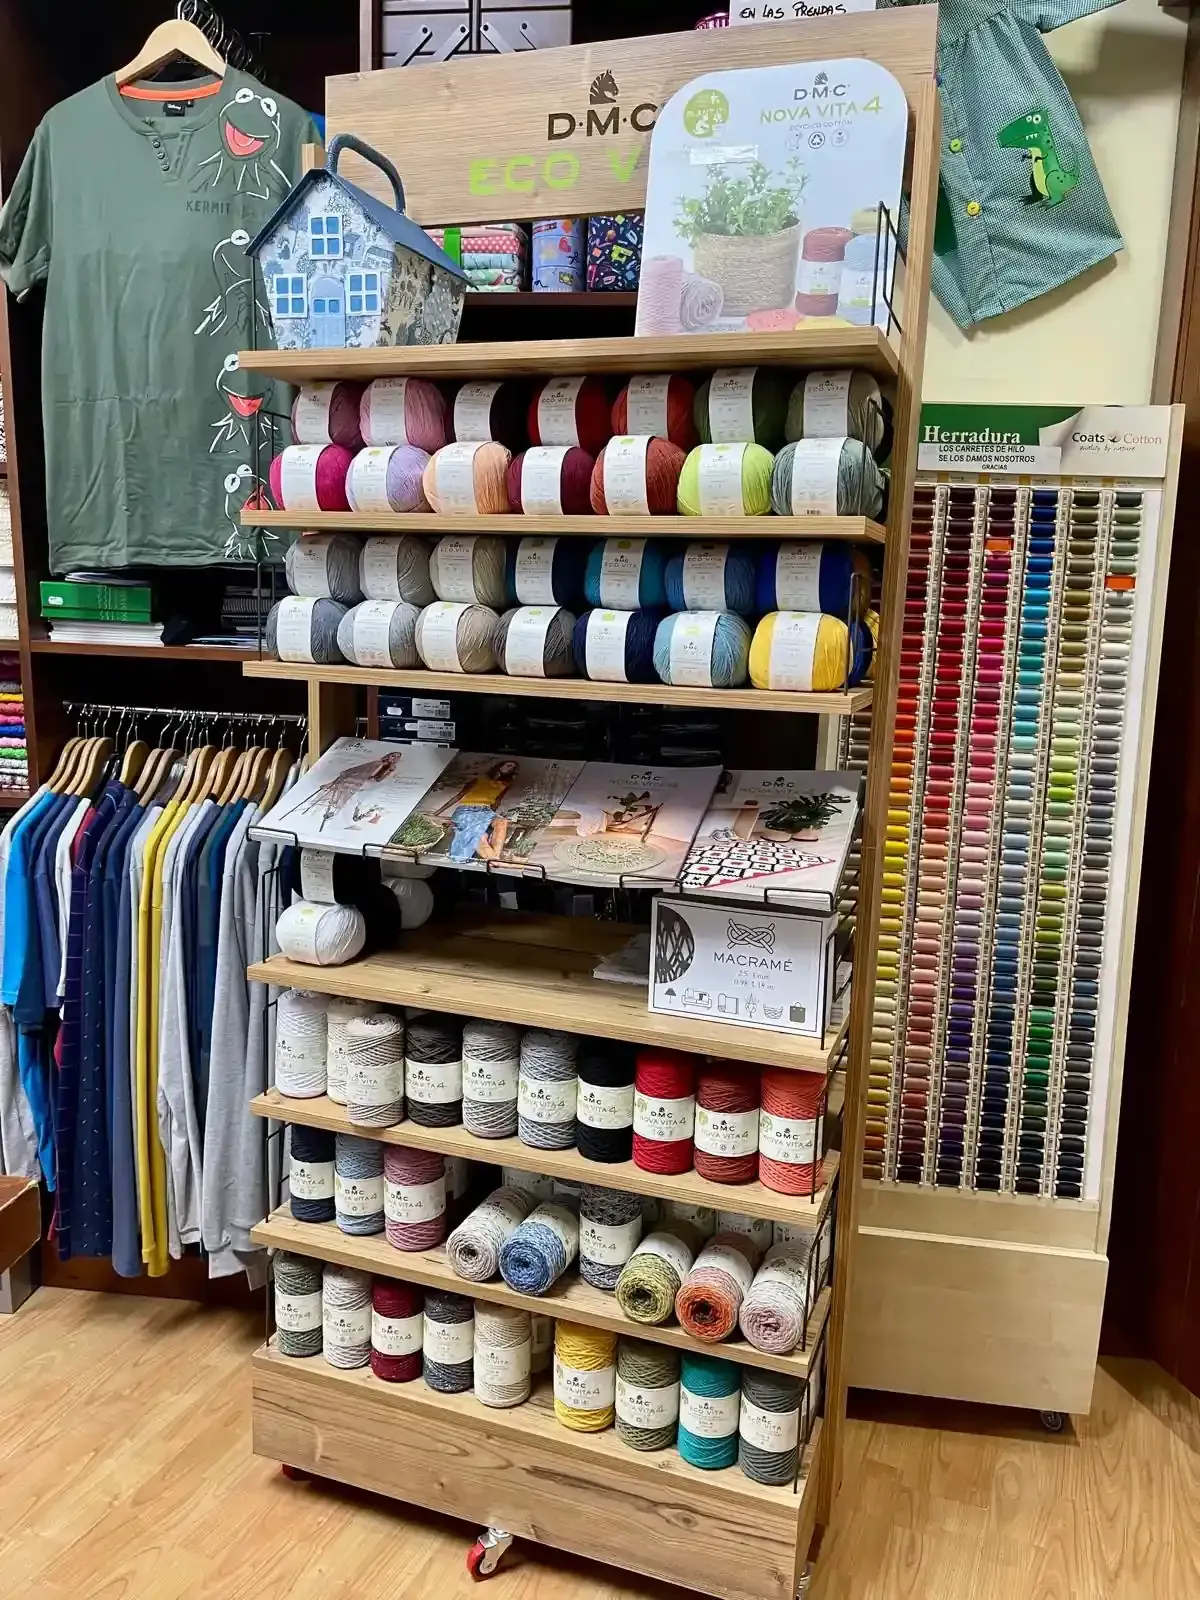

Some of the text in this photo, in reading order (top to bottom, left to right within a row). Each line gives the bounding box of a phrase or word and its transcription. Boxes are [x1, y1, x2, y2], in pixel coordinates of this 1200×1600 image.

[739, 2, 847, 18] EN LAS PRENDAS
[760, 96, 882, 125] NOVA VITA 4
[469, 150, 580, 195] ECO
[186, 200, 230, 216] KERMIT
[923, 425, 1021, 444] Herradura
[1072, 432, 1162, 444] Coats Cotton
[955, 445, 995, 453] CARRETES
[994, 455, 1035, 463] NOSOTROS
[713, 951, 793, 972] MACRAMÉ
[412, 1073, 431, 1081] DMC
[531, 1092, 551, 1100] DMC
[584, 1095, 602, 1105] DMC
[391, 1193, 409, 1201] DMC
[585, 1231, 602, 1241] DMC
[567, 1380, 586, 1388] DMC
[629, 1397, 651, 1406] DMC
